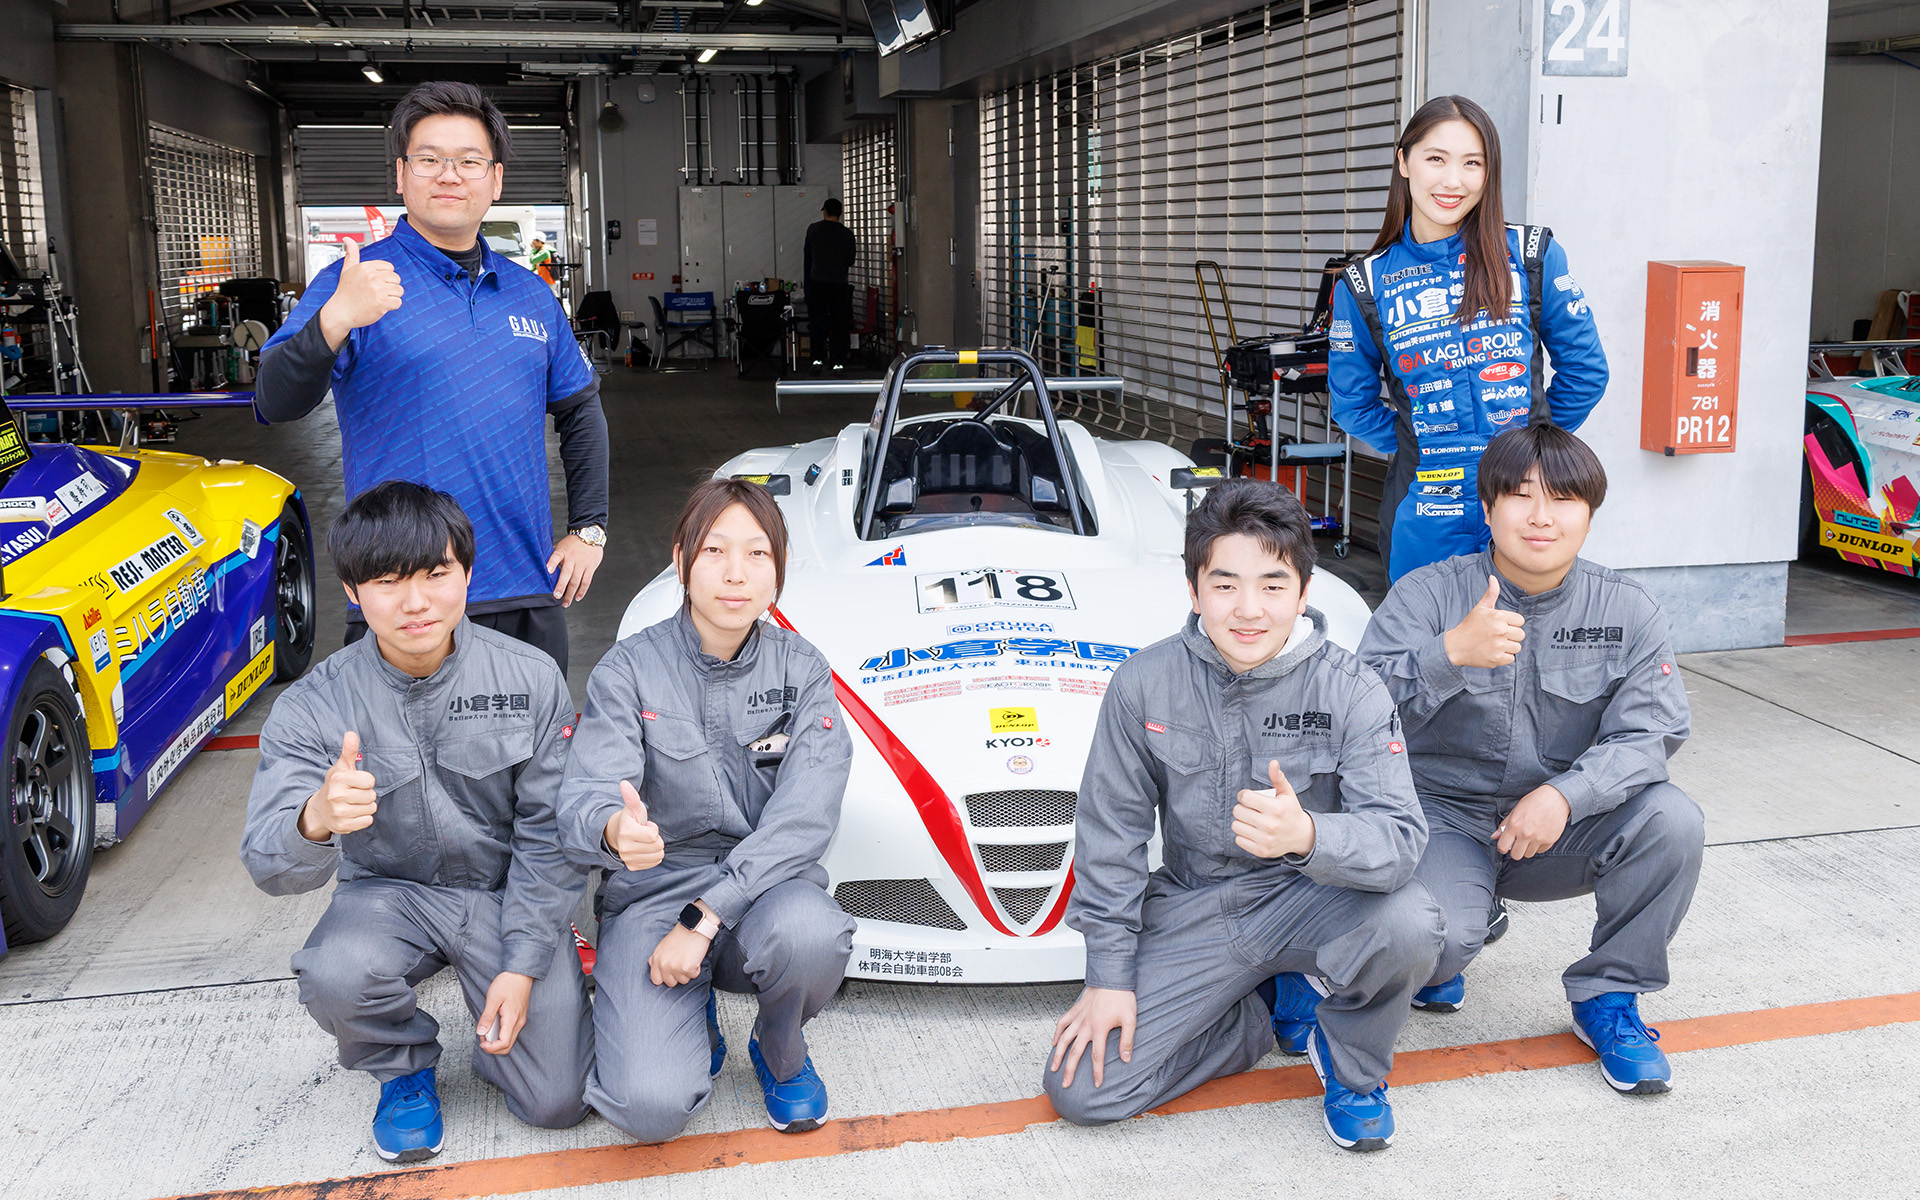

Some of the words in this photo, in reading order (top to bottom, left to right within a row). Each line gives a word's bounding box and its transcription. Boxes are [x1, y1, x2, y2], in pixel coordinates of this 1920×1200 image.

[1548, 0, 1625, 61] 24
[1381, 263, 1433, 285] BRIDE
[1414, 342, 1465, 369] AKAGI
[1467, 332, 1523, 353] GROUP
[1697, 300, 1720, 379] 消火器
[1445, 352, 1486, 370] DRIVING
[1487, 347, 1525, 360] SCHOOL
[1692, 396, 1719, 410] 781
[1677, 415, 1731, 443] PR12
[1426, 471, 1460, 479] DUNLOP
[1416, 502, 1464, 516] Komada
[1, 526, 46, 565] .YASUI
[140, 535, 188, 573] MASTER
[1837, 533, 1905, 557] DUNLOP
[924, 572, 1063, 604] 118
[114, 566, 211, 662] ミハラ自動車
[1552, 626, 1624, 643] 小倉学園
[236, 654, 271, 699] DUNLOP
[449, 693, 530, 713] 小倉学園
[747, 685, 798, 708] 小倉園
[1263, 711, 1332, 731] 小倉学園
[869, 948, 952, 964] 明海大学歯学部
[858, 960, 964, 978] 体育会自動車部OB会
